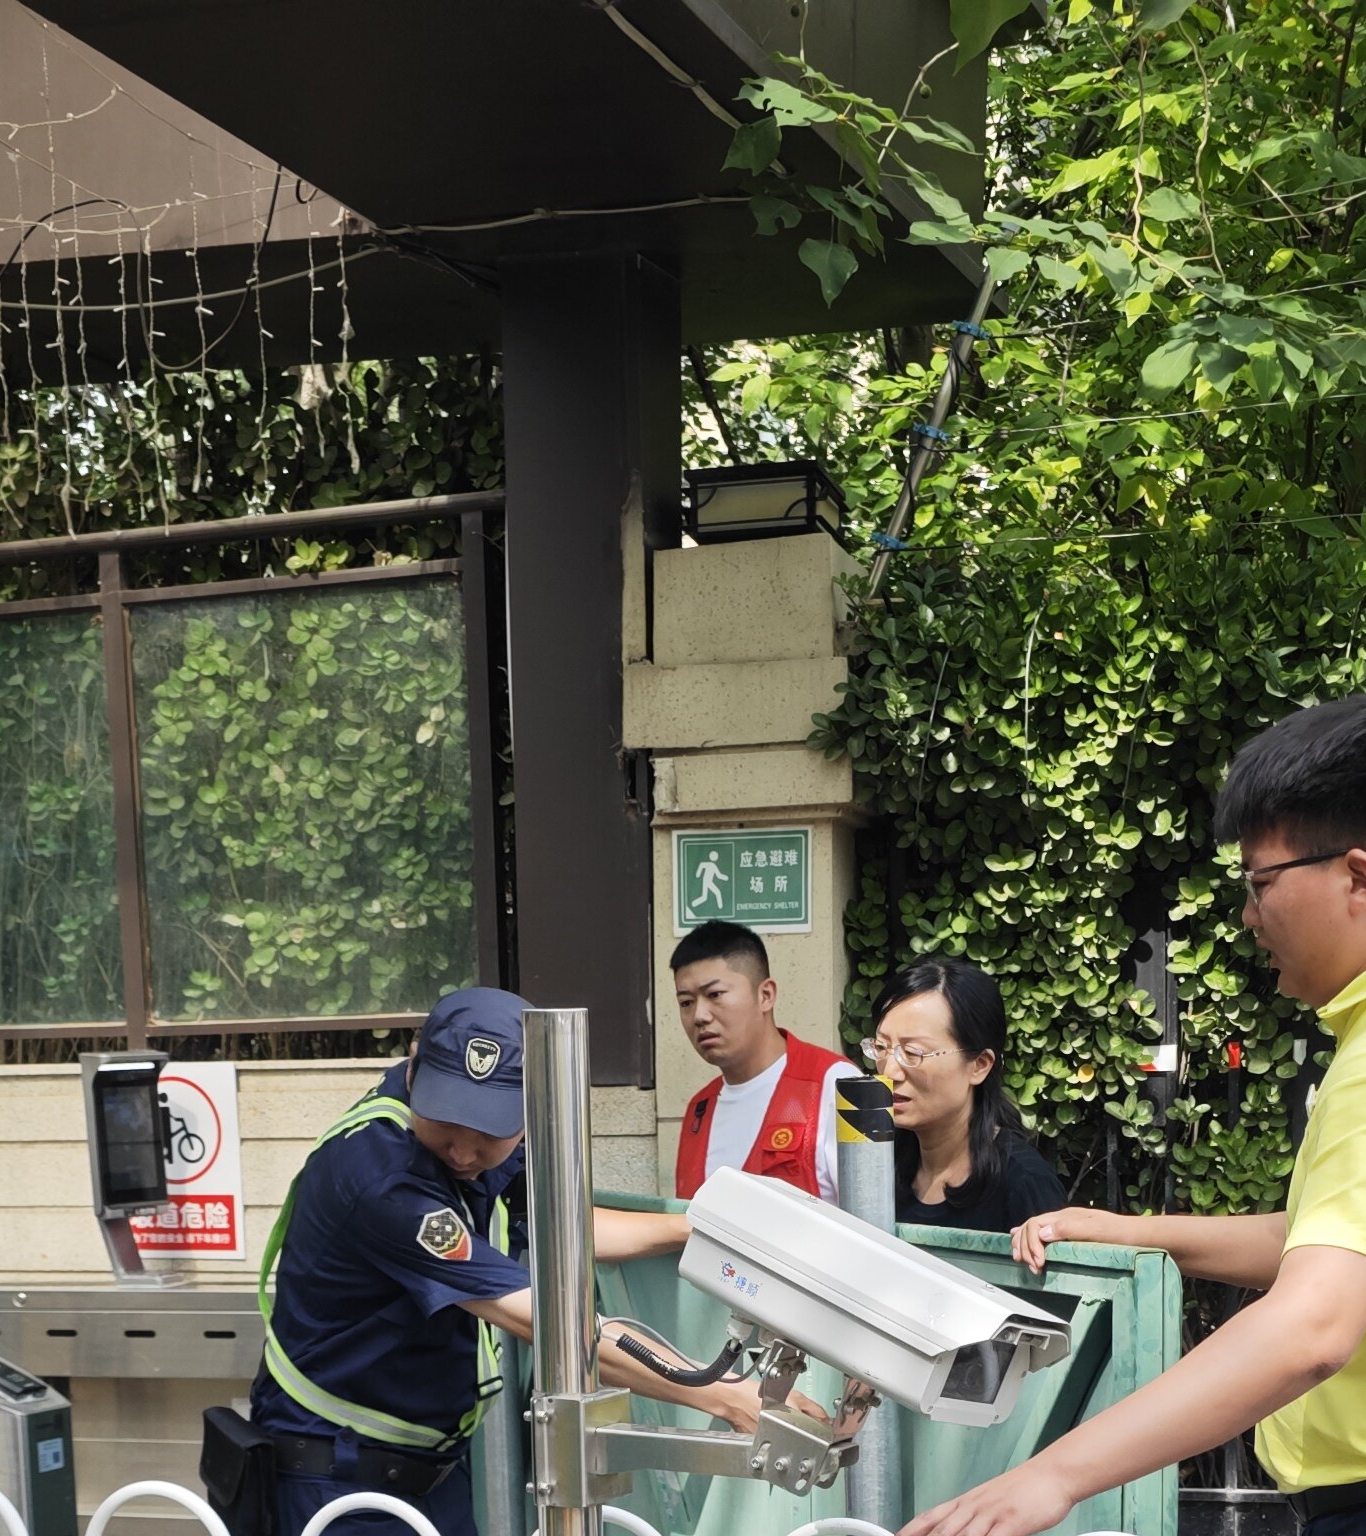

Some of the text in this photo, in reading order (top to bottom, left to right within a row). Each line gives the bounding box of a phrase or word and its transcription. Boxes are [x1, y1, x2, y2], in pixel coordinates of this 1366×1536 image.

[740, 850, 798, 867] 应急避难
[736, 901, 799, 911] EMERGENCY SHELTER
